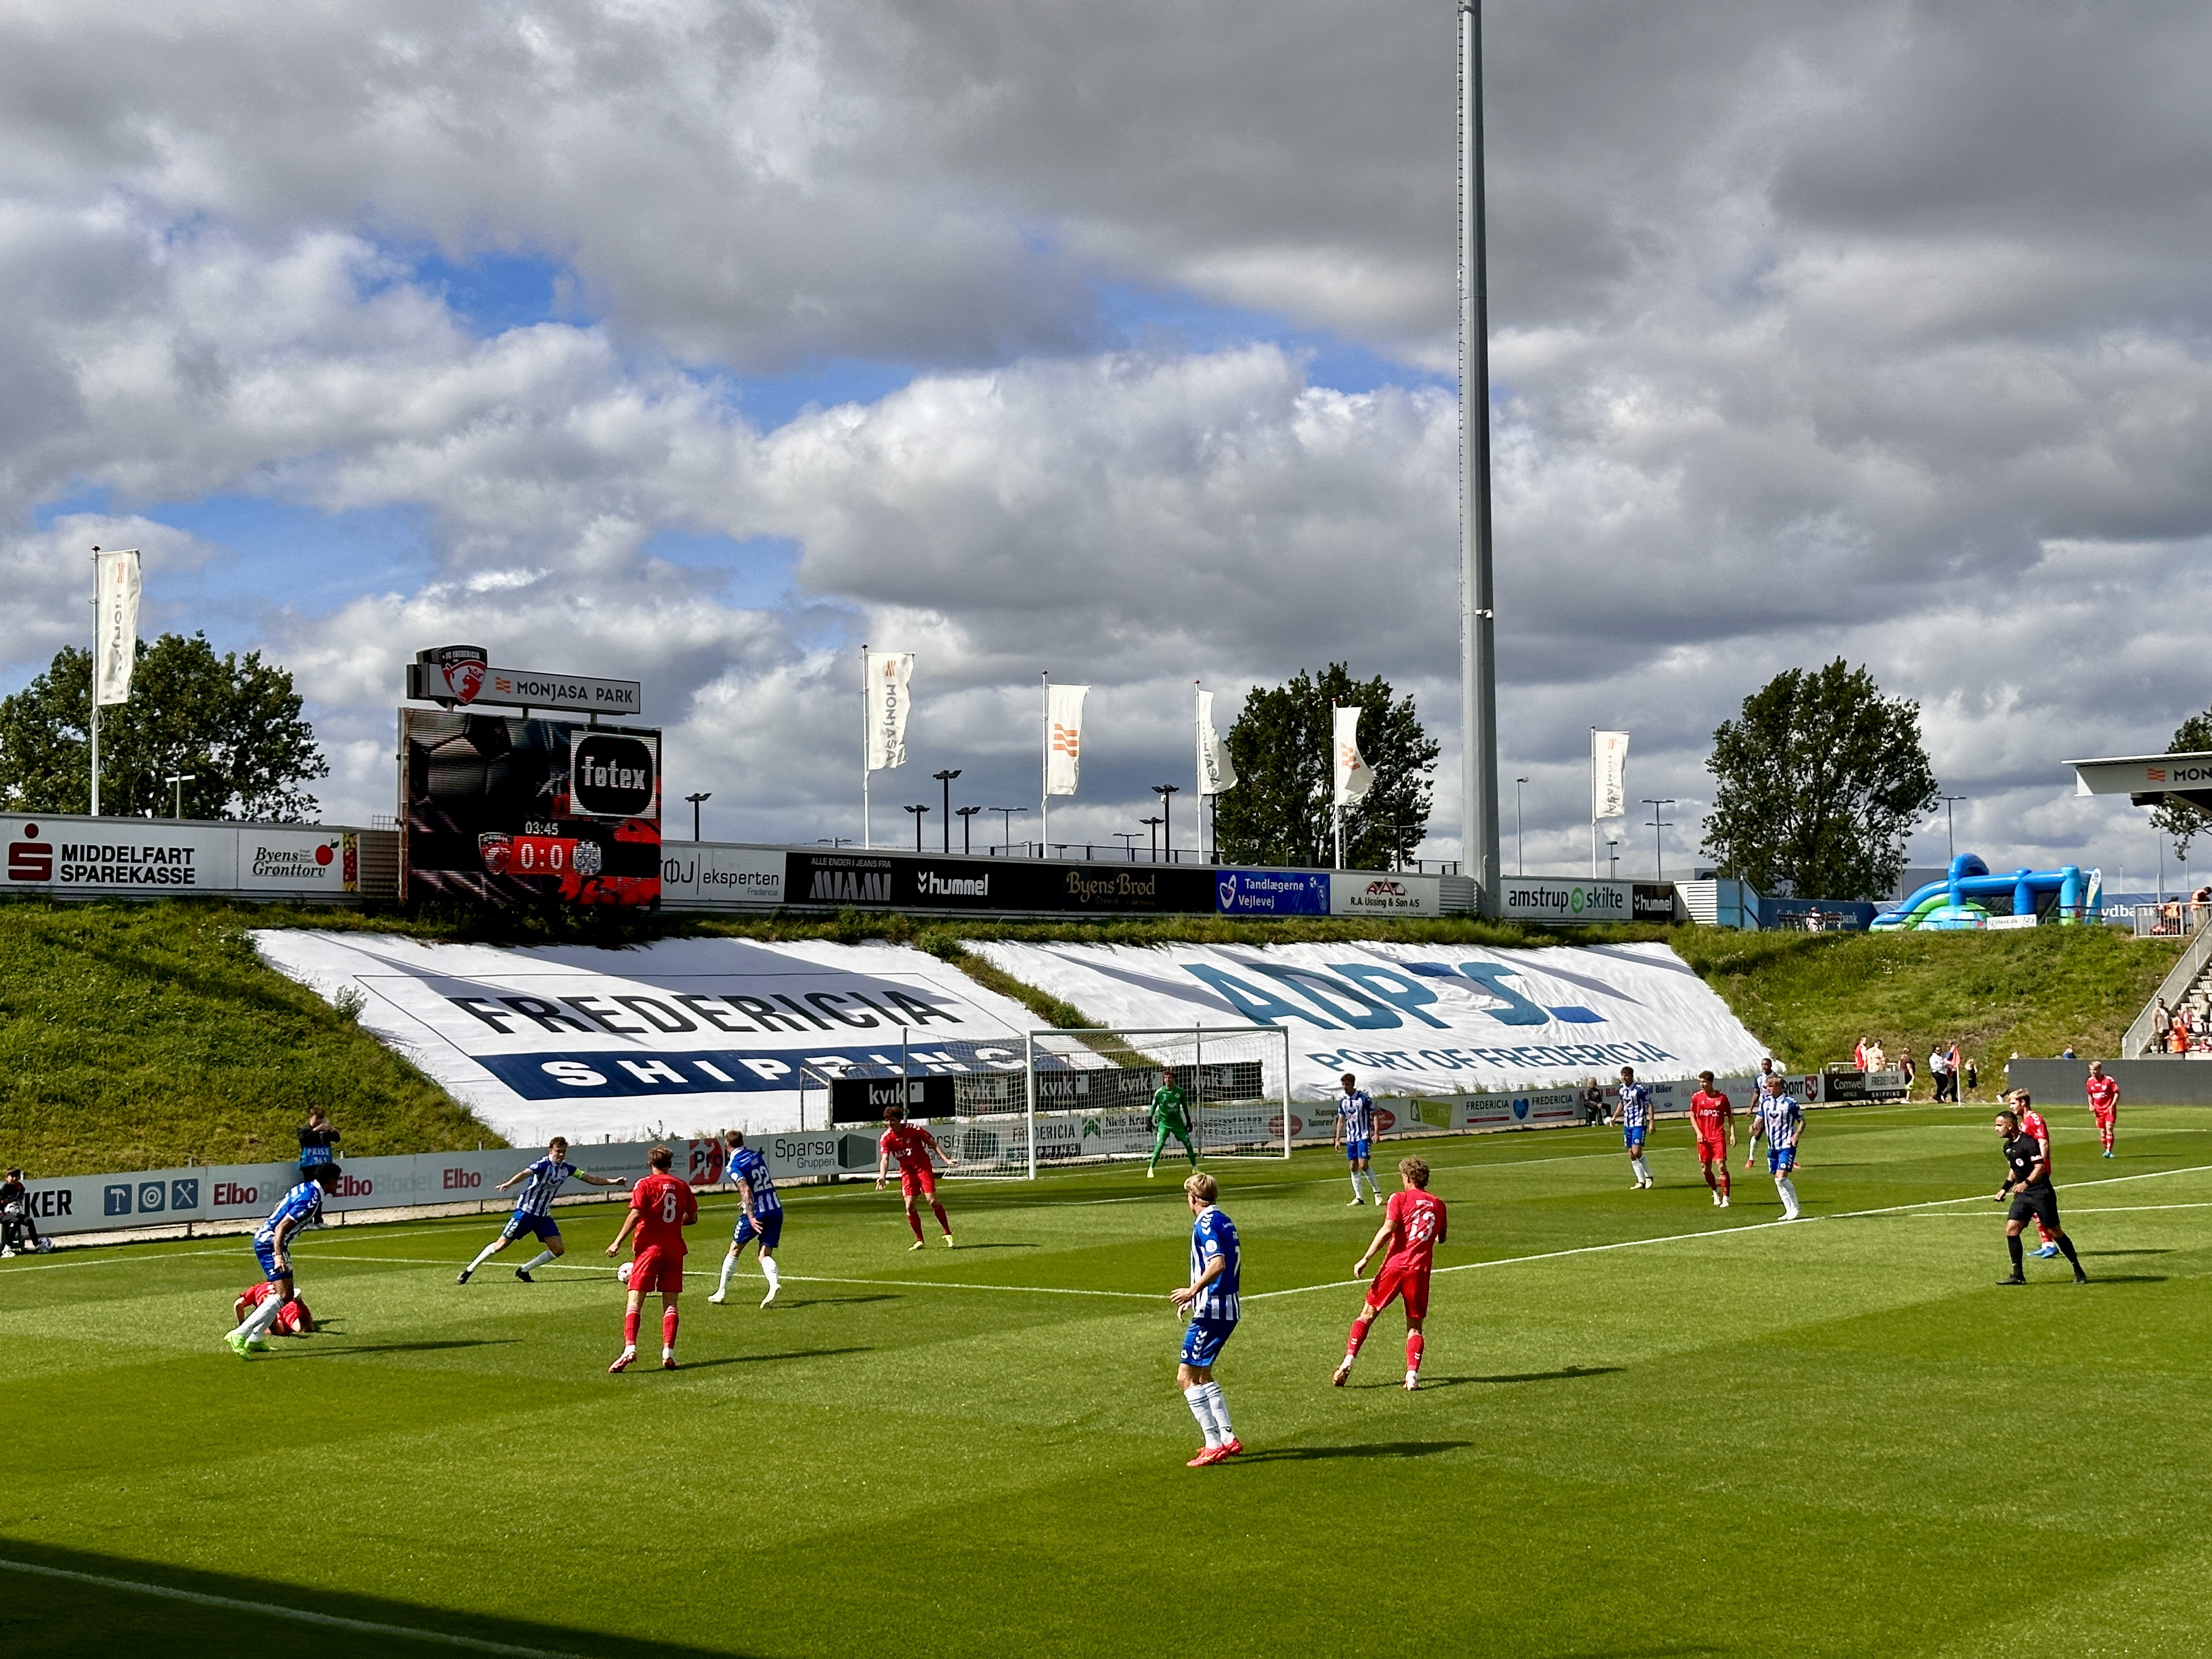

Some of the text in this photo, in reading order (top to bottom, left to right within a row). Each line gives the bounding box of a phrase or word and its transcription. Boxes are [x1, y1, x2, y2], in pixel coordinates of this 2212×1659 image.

[517, 680, 633, 704] MONJASA PARK
[883, 684, 898, 762] MONJASA
[61, 844, 195, 865] MIDDELFART
[255, 847, 299, 864] Byens
[811, 857, 827, 866] ALLE
[828, 858, 851, 866] ENDER
[855, 859, 877, 867] JEANS
[878, 860, 891, 868] FRA
[60, 865, 195, 885] SPAREKASSE
[252, 861, 326, 877] Grønttorv
[661, 857, 779, 888] ØJ eksperten
[747, 887, 778, 896] Fredericia
[929, 871, 989, 896] hummel
[1066, 871, 1156, 903] Byens Brød
[1244, 878, 1304, 893] Tandlægerne
[1238, 895, 1274, 909] Vejlevej
[1364, 897, 1387, 909] Ussing
[1388, 898, 1393, 907] &
[1409, 899, 1420, 907] A/S
[1509, 886, 1623, 913] amstrup skilte
[1640, 893, 1672, 911] hummel
[443, 991, 964, 1035] FREDERICIA
[1304, 1040, 1681, 1072] PORT OF FREDERICIA
[1606, 1087, 1619, 1097] Bile
[1655, 1085, 1672, 1093] Biler
[1782, 1080, 1804, 1095] PORT
[1833, 1076, 1865, 1090] Comwell
[868, 1082, 905, 1105] kvik
[1531, 1094, 1573, 1107] FREDERICIA
[1465, 1099, 1509, 1111] FREDERICIA
[775, 1138, 834, 1163] Sparsø
[797, 1157, 835, 1170] Gruppen
[751, 1165, 773, 1193] 22
[662, 1192, 676, 1223] 8
[1408, 1209, 1436, 1242] 13
